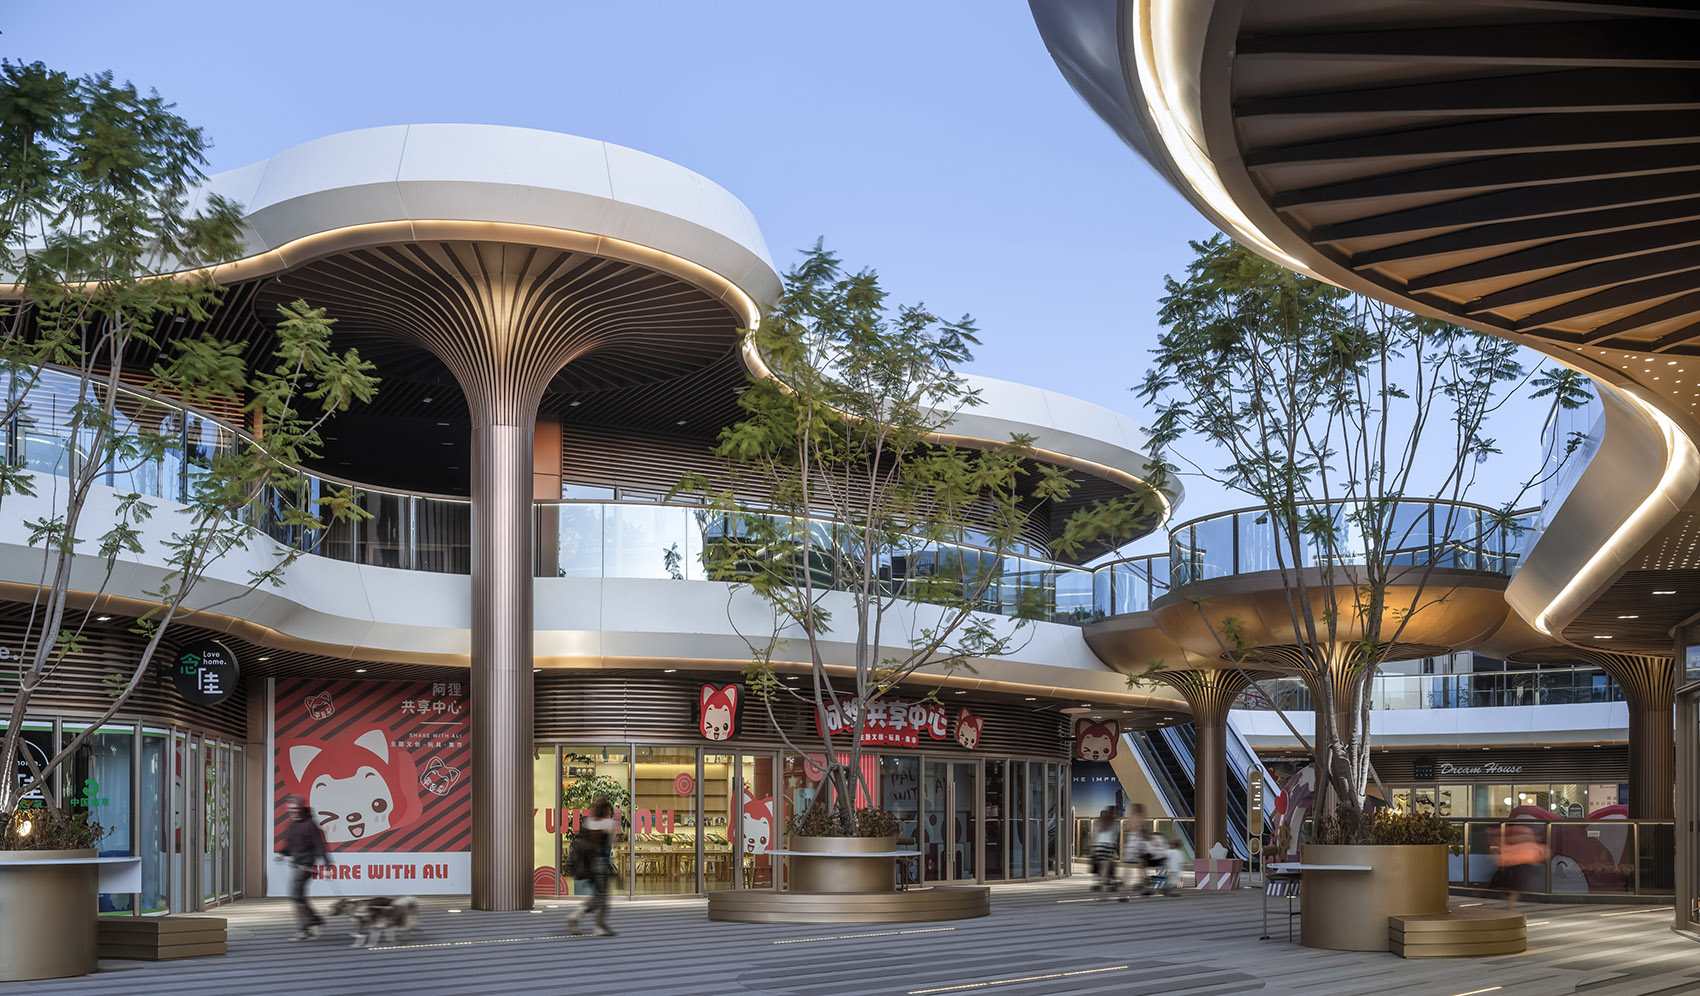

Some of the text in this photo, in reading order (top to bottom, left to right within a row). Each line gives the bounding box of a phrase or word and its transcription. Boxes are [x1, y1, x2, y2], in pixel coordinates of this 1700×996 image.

[432, 683, 462, 696] 阿狸
[401, 699, 462, 715] 共享中心
[1440, 763, 1482, 775] Dream
[1484, 762, 1523, 773] House
[635, 808, 675, 834] ALI
[312, 864, 448, 880] HARE WITH ALI
